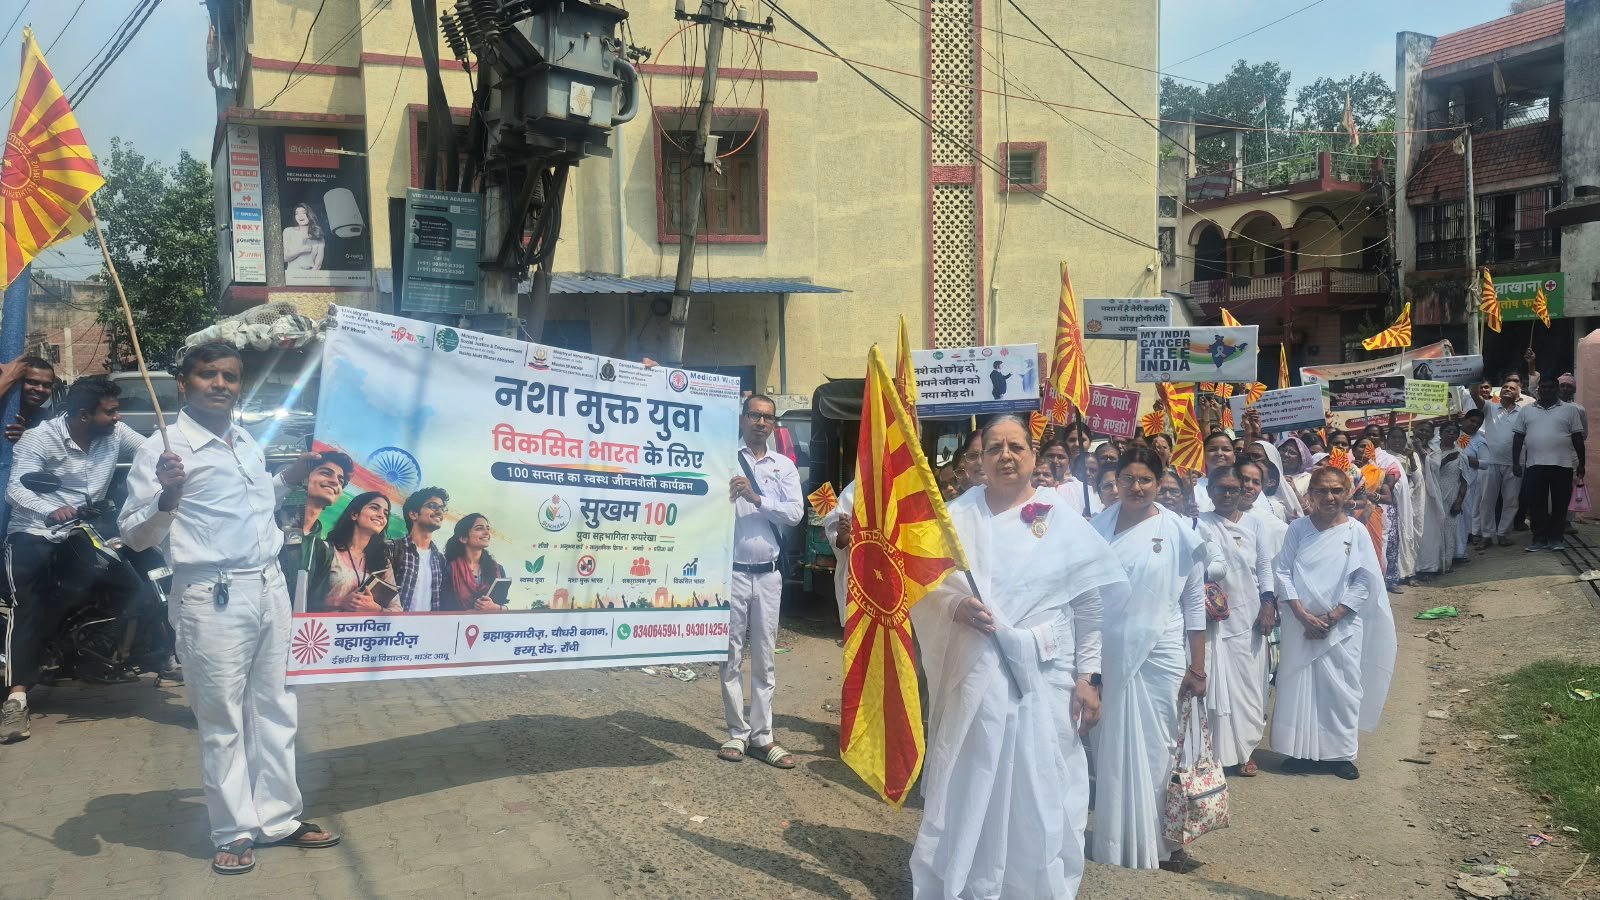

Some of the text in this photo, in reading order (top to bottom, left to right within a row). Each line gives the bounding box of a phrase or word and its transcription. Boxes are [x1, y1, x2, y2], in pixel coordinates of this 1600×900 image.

[1140, 330, 1190, 339] MY INDIA
[1140, 338, 1190, 348] CANCER
[1141, 348, 1190, 360] FREE
[930, 364, 944, 374] को
[944, 364, 963, 374] छोड़
[965, 362, 978, 373] दो,
[1140, 360, 1190, 372] INDIA
[690, 372, 720, 382] Medical
[916, 376, 980, 387] अपने जीवन को
[921, 389, 974, 400] नया मोड़ दो।
[1092, 390, 1108, 408] शिव
[494, 376, 703, 442] नशा मुक्त युवा
[1092, 413, 1100, 428] के
[492, 423, 704, 469] विकसित भारत के लिए
[506, 466, 694, 492] 100 सप्ताह का स्वस्थ जीवनशैली कार्यक्रम
[580, 498, 678, 530] सुखम 100
[576, 530, 657, 543] युवा सहभागिता रूपरेखा
[336, 619, 391, 634] प्रजापिता
[632, 622, 729, 639] 8340645941, 943014254
[514, 645, 538, 656] हरमू
[538, 643, 557, 654] रोड,
